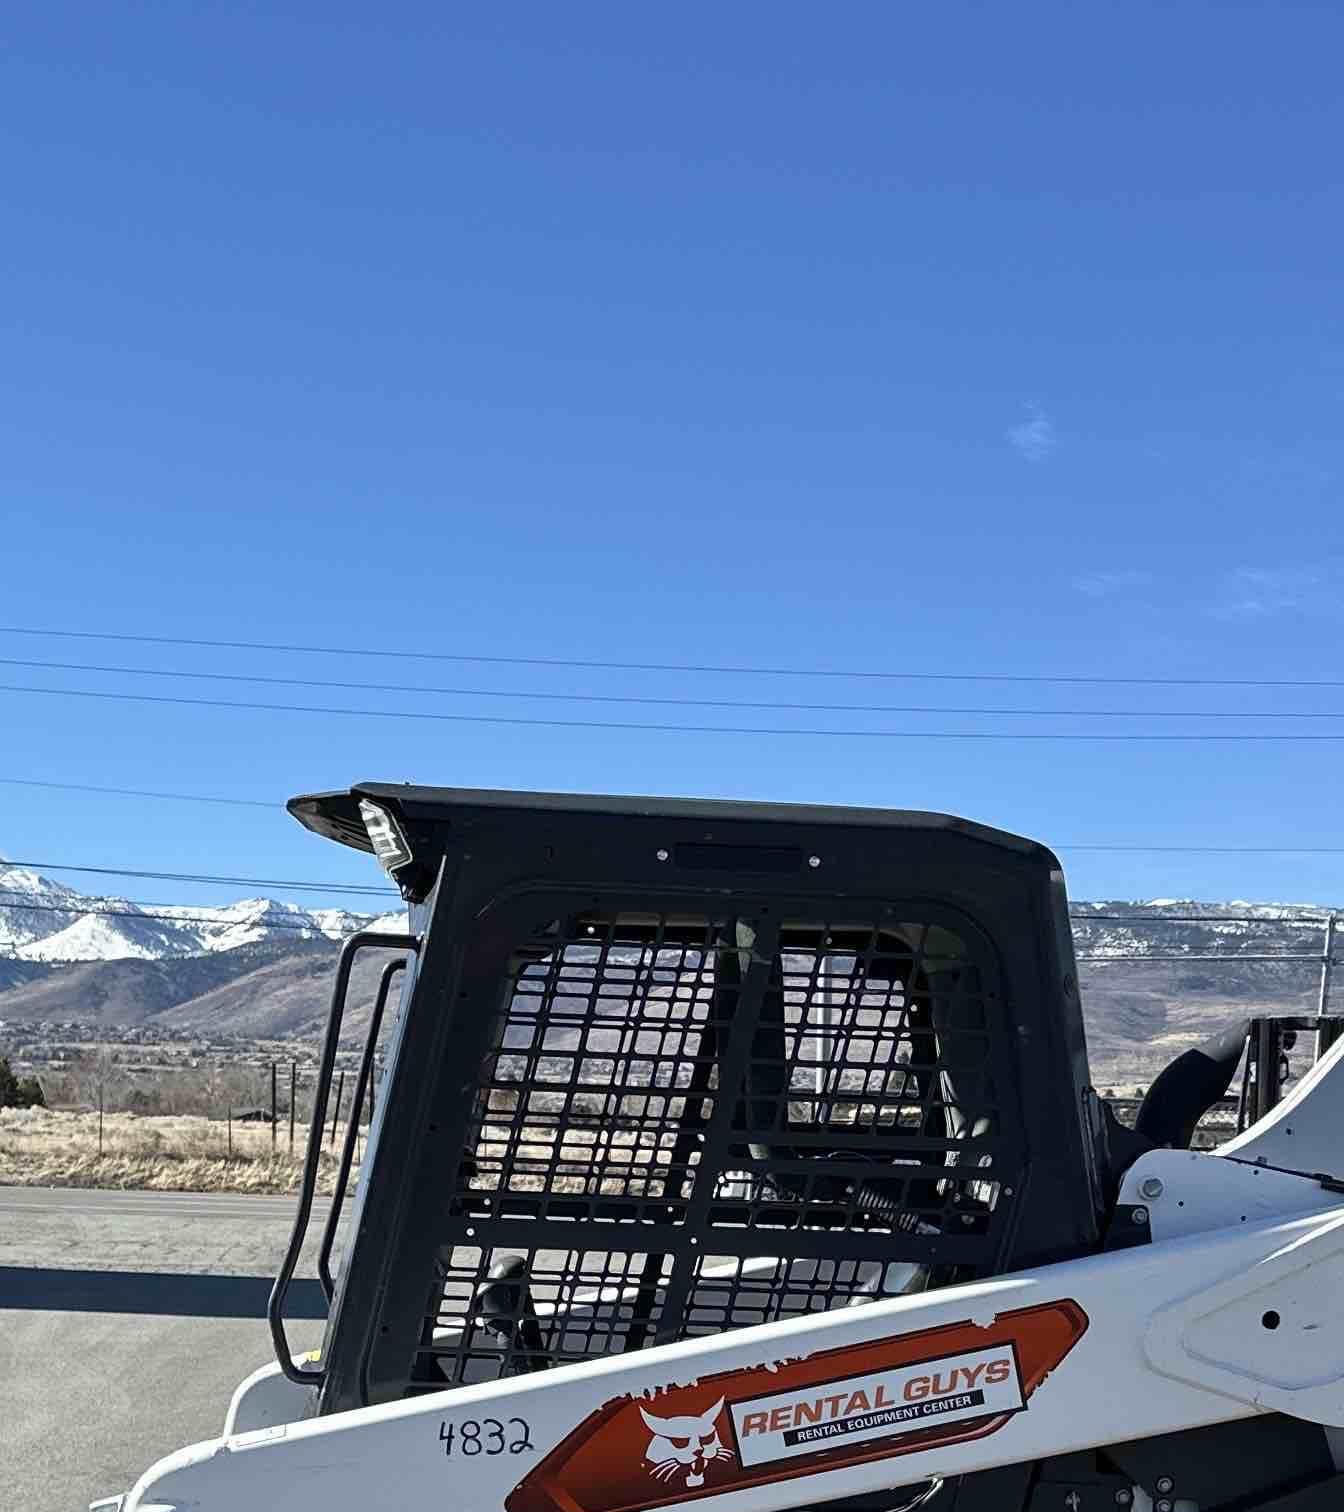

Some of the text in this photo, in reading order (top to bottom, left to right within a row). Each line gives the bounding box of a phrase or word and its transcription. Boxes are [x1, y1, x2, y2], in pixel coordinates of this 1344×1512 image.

[742, 1359, 1010, 1438] RENTAL GUYS
[798, 1395, 972, 1442] RENTAL EQUIPMENT CENTER
[439, 1417, 534, 1455] 4832
